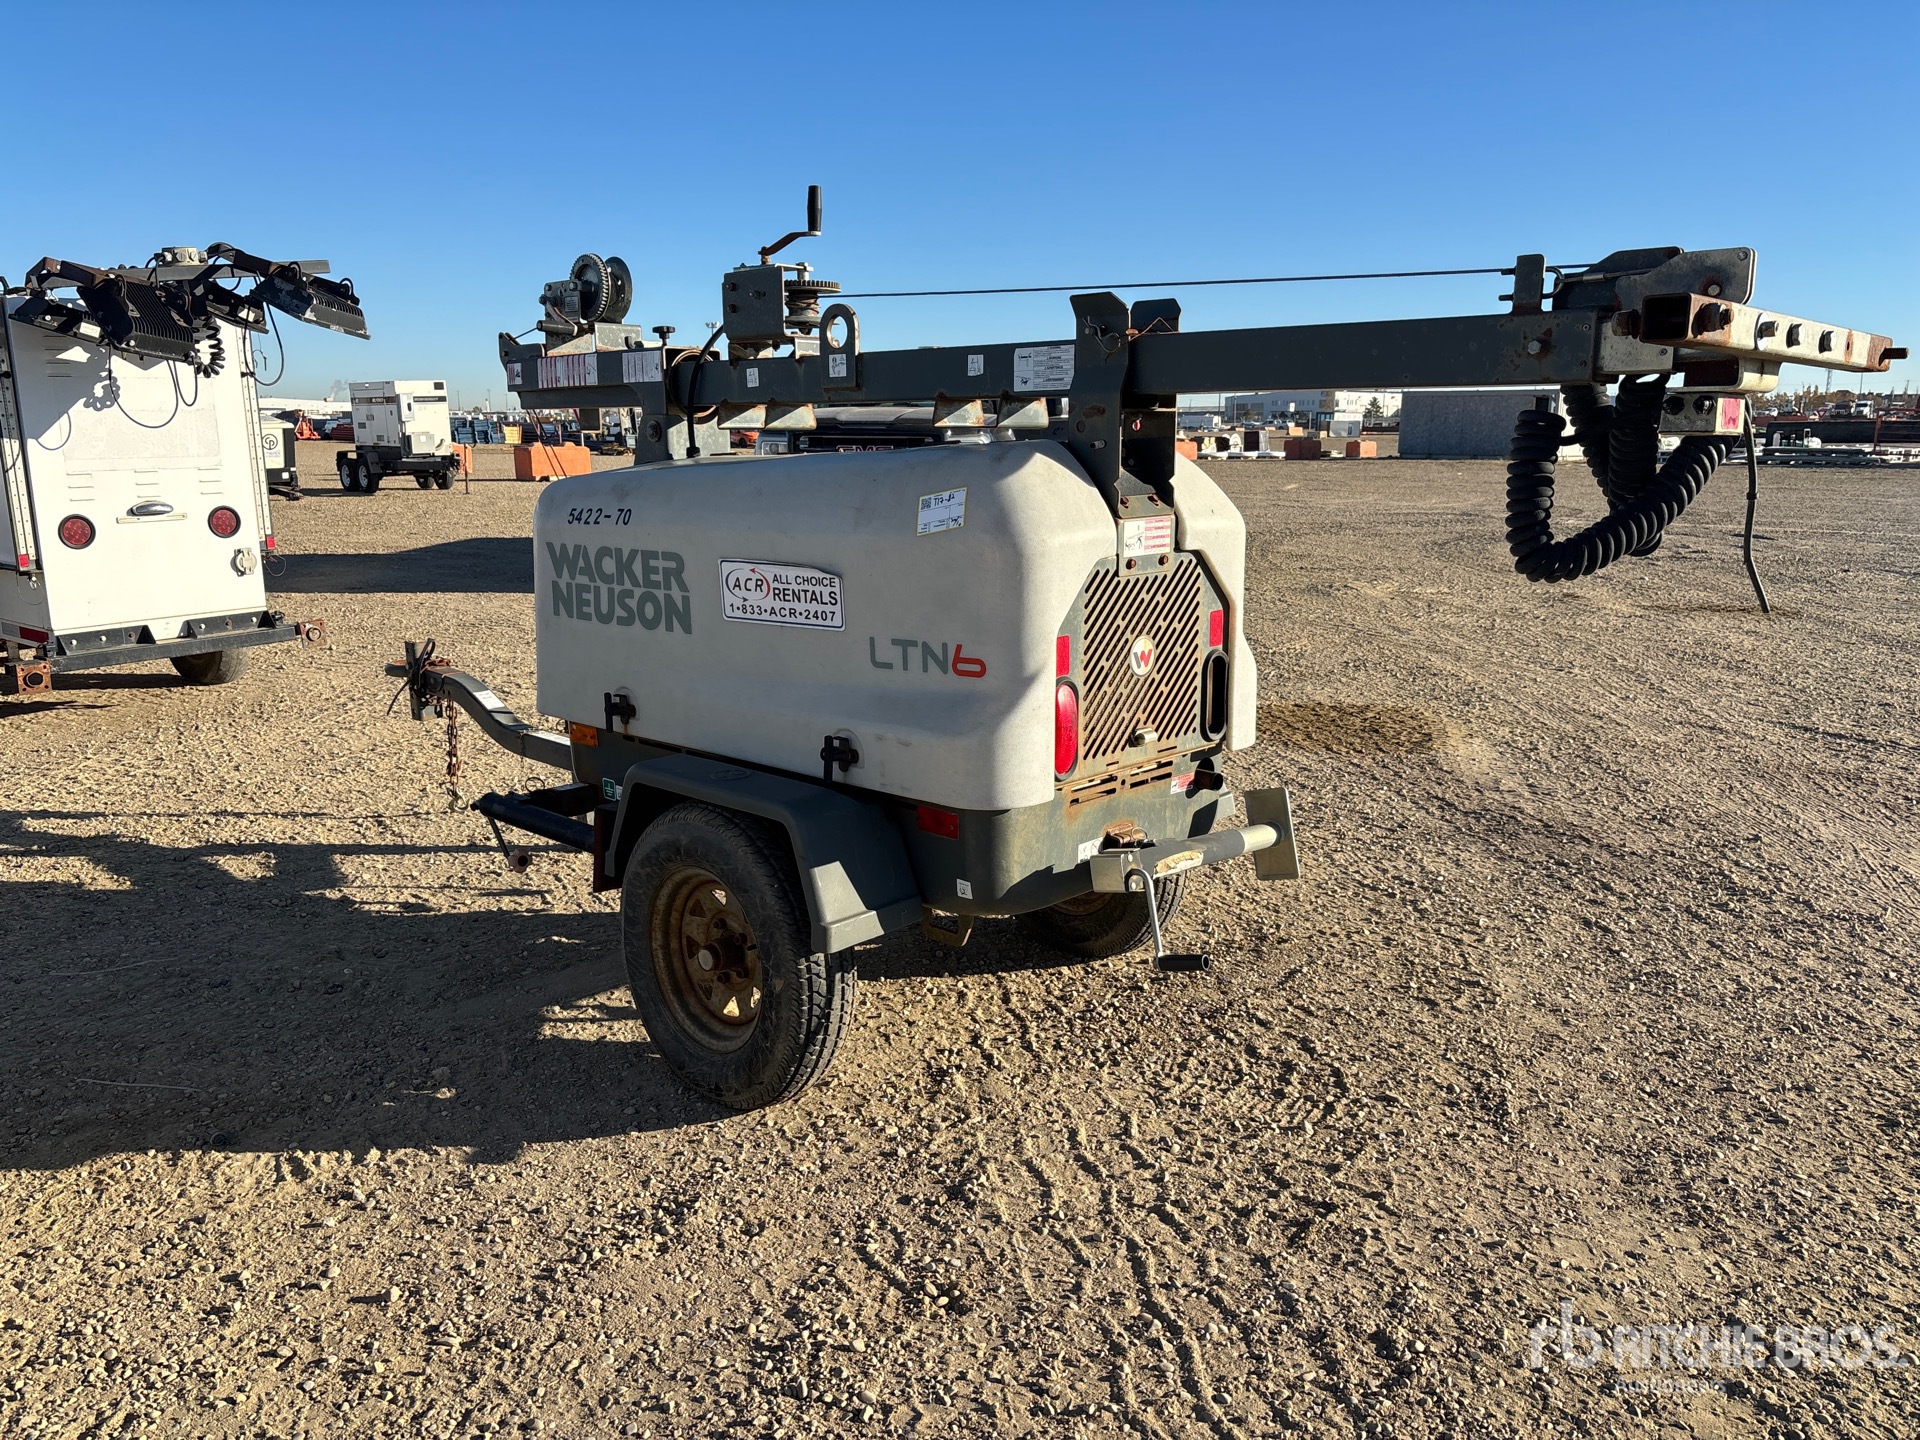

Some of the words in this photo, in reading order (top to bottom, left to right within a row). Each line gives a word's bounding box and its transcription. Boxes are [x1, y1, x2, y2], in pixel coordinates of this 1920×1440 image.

[567, 508, 632, 525] 5422-70
[545, 541, 690, 593] WACKER
[732, 577, 764, 593] ACR
[772, 573, 792, 585] ALL
[794, 575, 836, 588] CHOICE
[772, 587, 838, 606] RENTALS
[551, 580, 692, 635] NEUSON
[869, 636, 987, 678] LTN6
